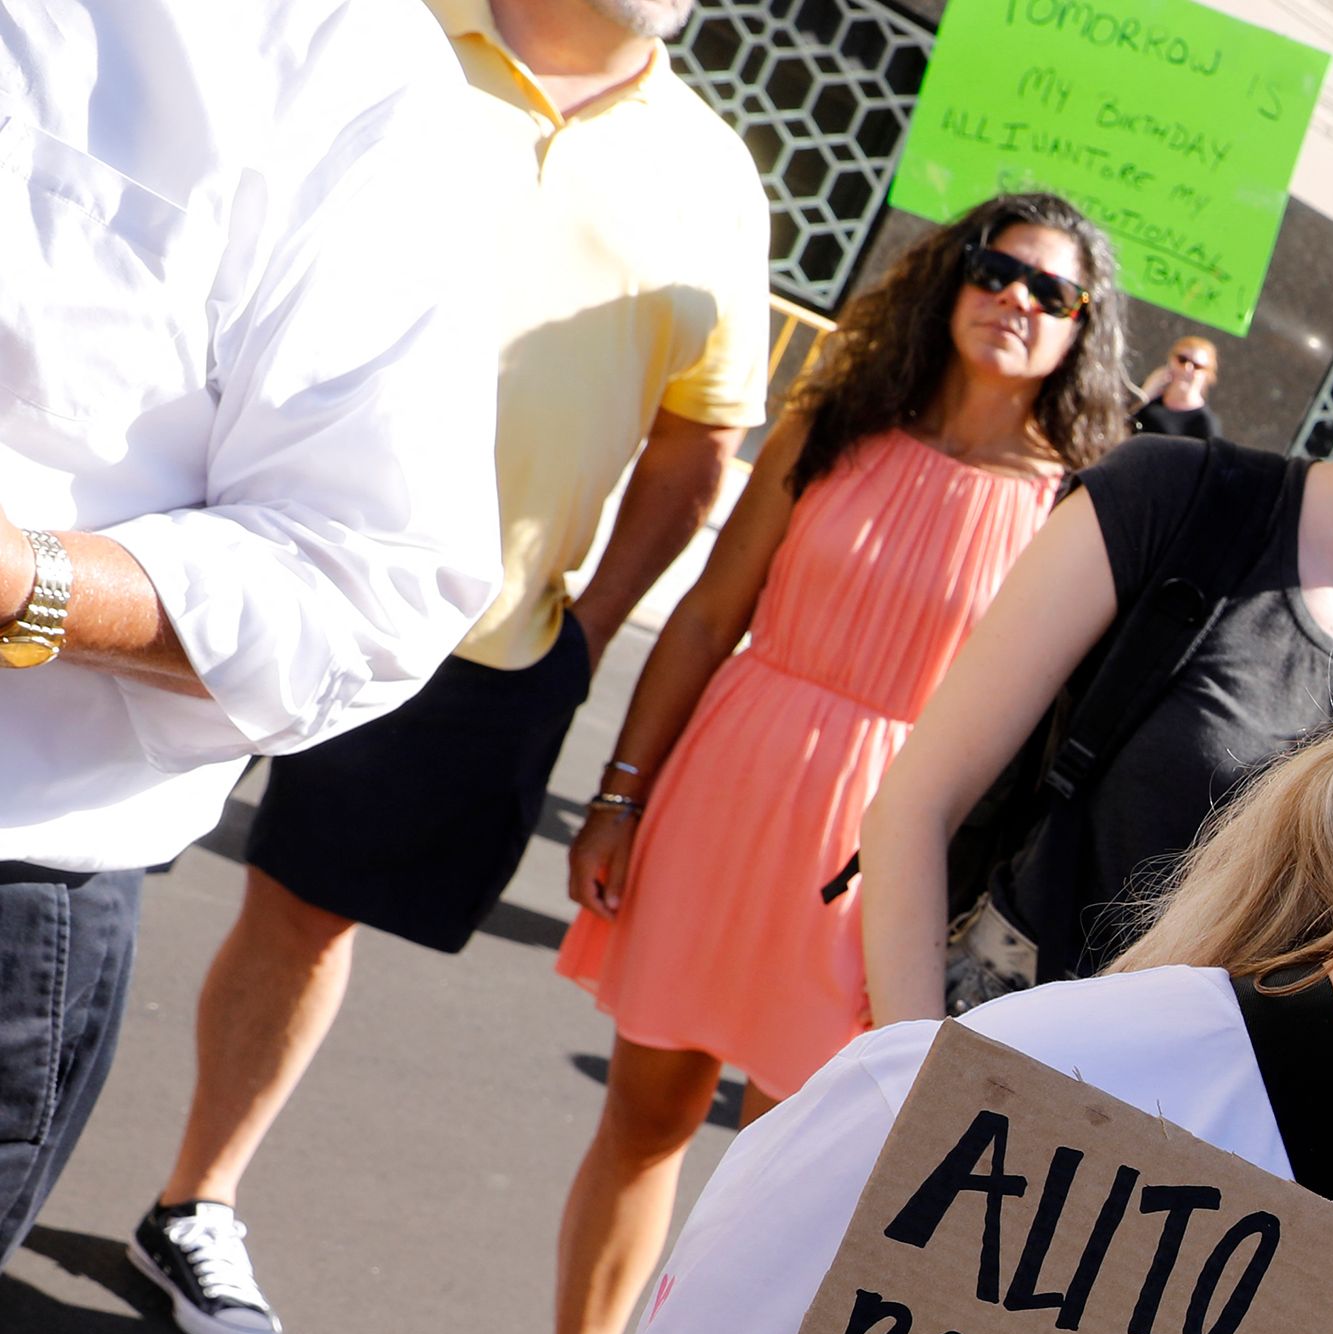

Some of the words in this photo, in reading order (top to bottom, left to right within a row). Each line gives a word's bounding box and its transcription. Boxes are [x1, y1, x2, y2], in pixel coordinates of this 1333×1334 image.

[1017, 65, 1073, 113] MY
[1246, 73, 1282, 121] IS
[940, 107, 991, 143] ALL
[997, 121, 1030, 152] I
